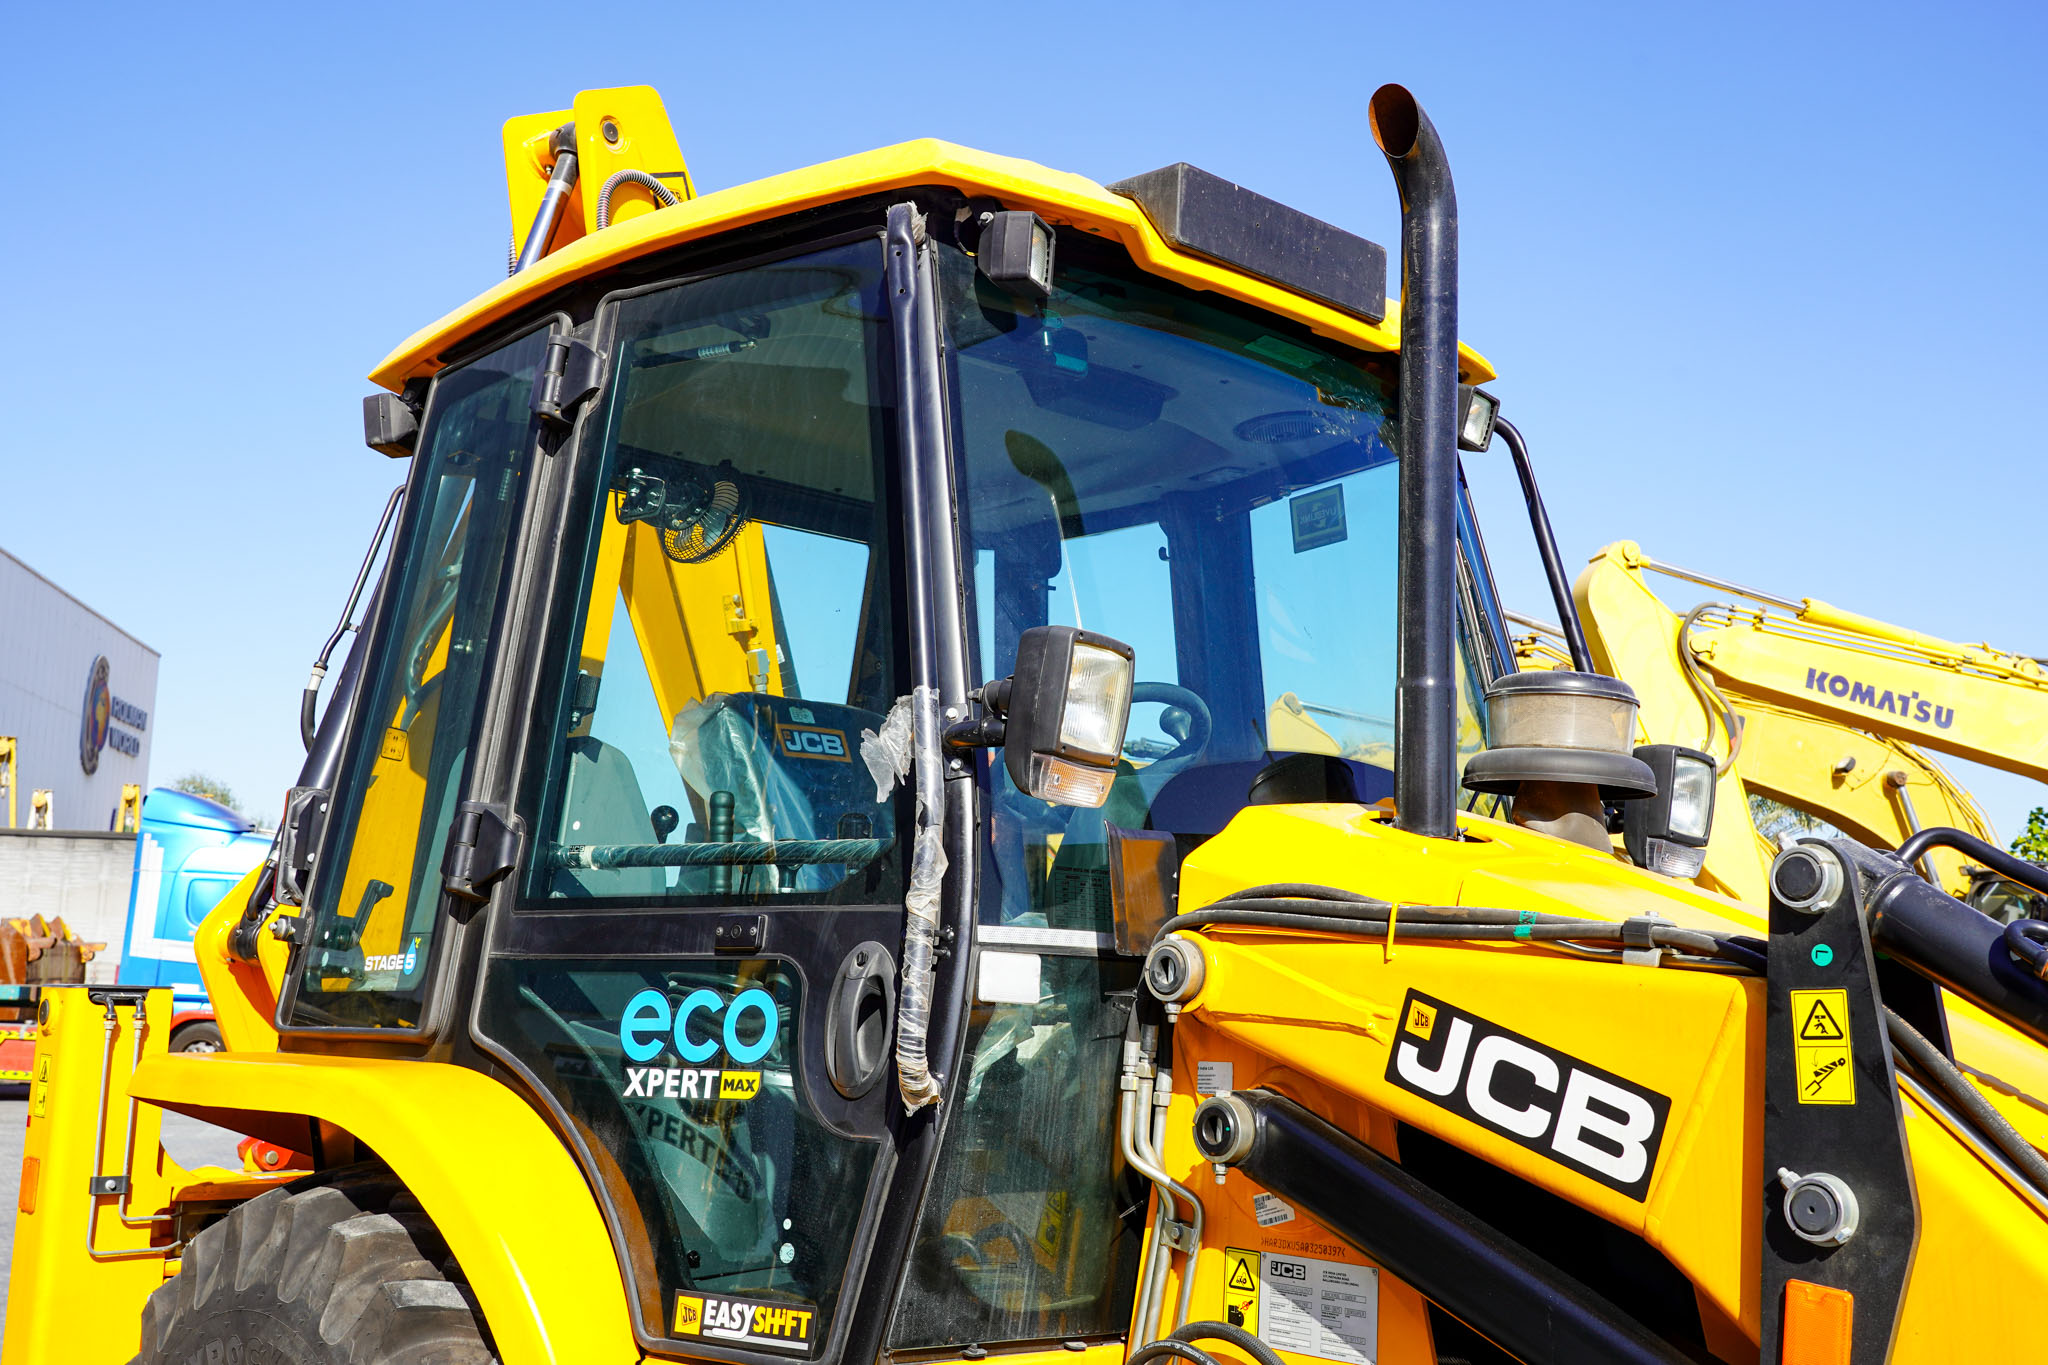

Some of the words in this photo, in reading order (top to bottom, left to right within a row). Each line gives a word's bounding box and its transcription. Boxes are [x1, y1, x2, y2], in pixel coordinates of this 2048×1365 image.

[1805, 667, 1954, 729] KOMATSU
[785, 731, 845, 755] JCB
[620, 988, 779, 1064] eco
[1414, 1010, 1429, 1027] JCB
[622, 1068, 720, 1099] XPERT
[722, 1078, 756, 1092] MAX
[1397, 1016, 1655, 1183] JCB
[1271, 1262, 1305, 1279] JCB
[682, 1306, 697, 1323] JCB
